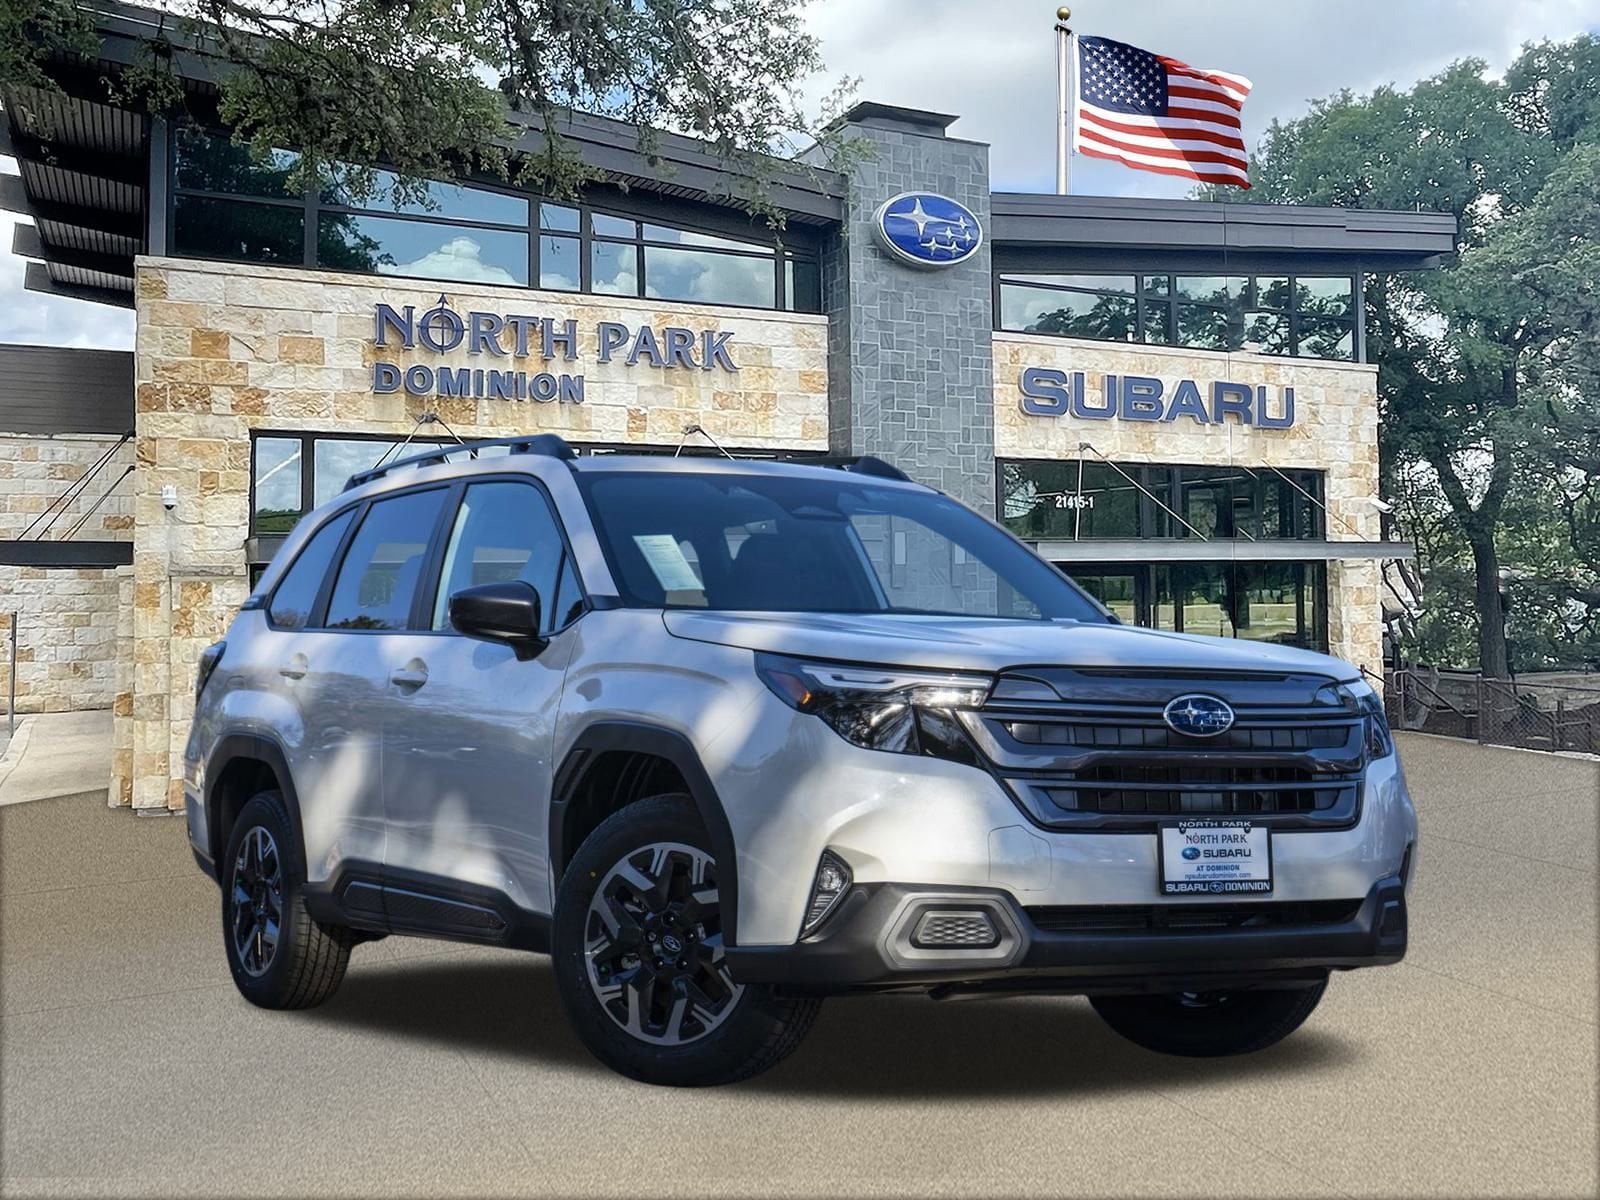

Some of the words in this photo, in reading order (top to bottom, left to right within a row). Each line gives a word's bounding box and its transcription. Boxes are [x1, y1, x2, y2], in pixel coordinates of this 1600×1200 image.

[375, 296, 579, 362] NORTH
[597, 321, 740, 373] PARK
[373, 362, 585, 405] DOMINION
[1019, 367, 1295, 430] SUBARU
[1186, 833, 1218, 845] NORTH
[1221, 834, 1248, 844] PARK
[1203, 848, 1251, 859] SUBARU
[1196, 864, 1204, 872] AT
[1206, 864, 1240, 872] DOMINION
[1165, 882, 1209, 892] SUBARU
[1224, 881, 1270, 892] DOMINION
